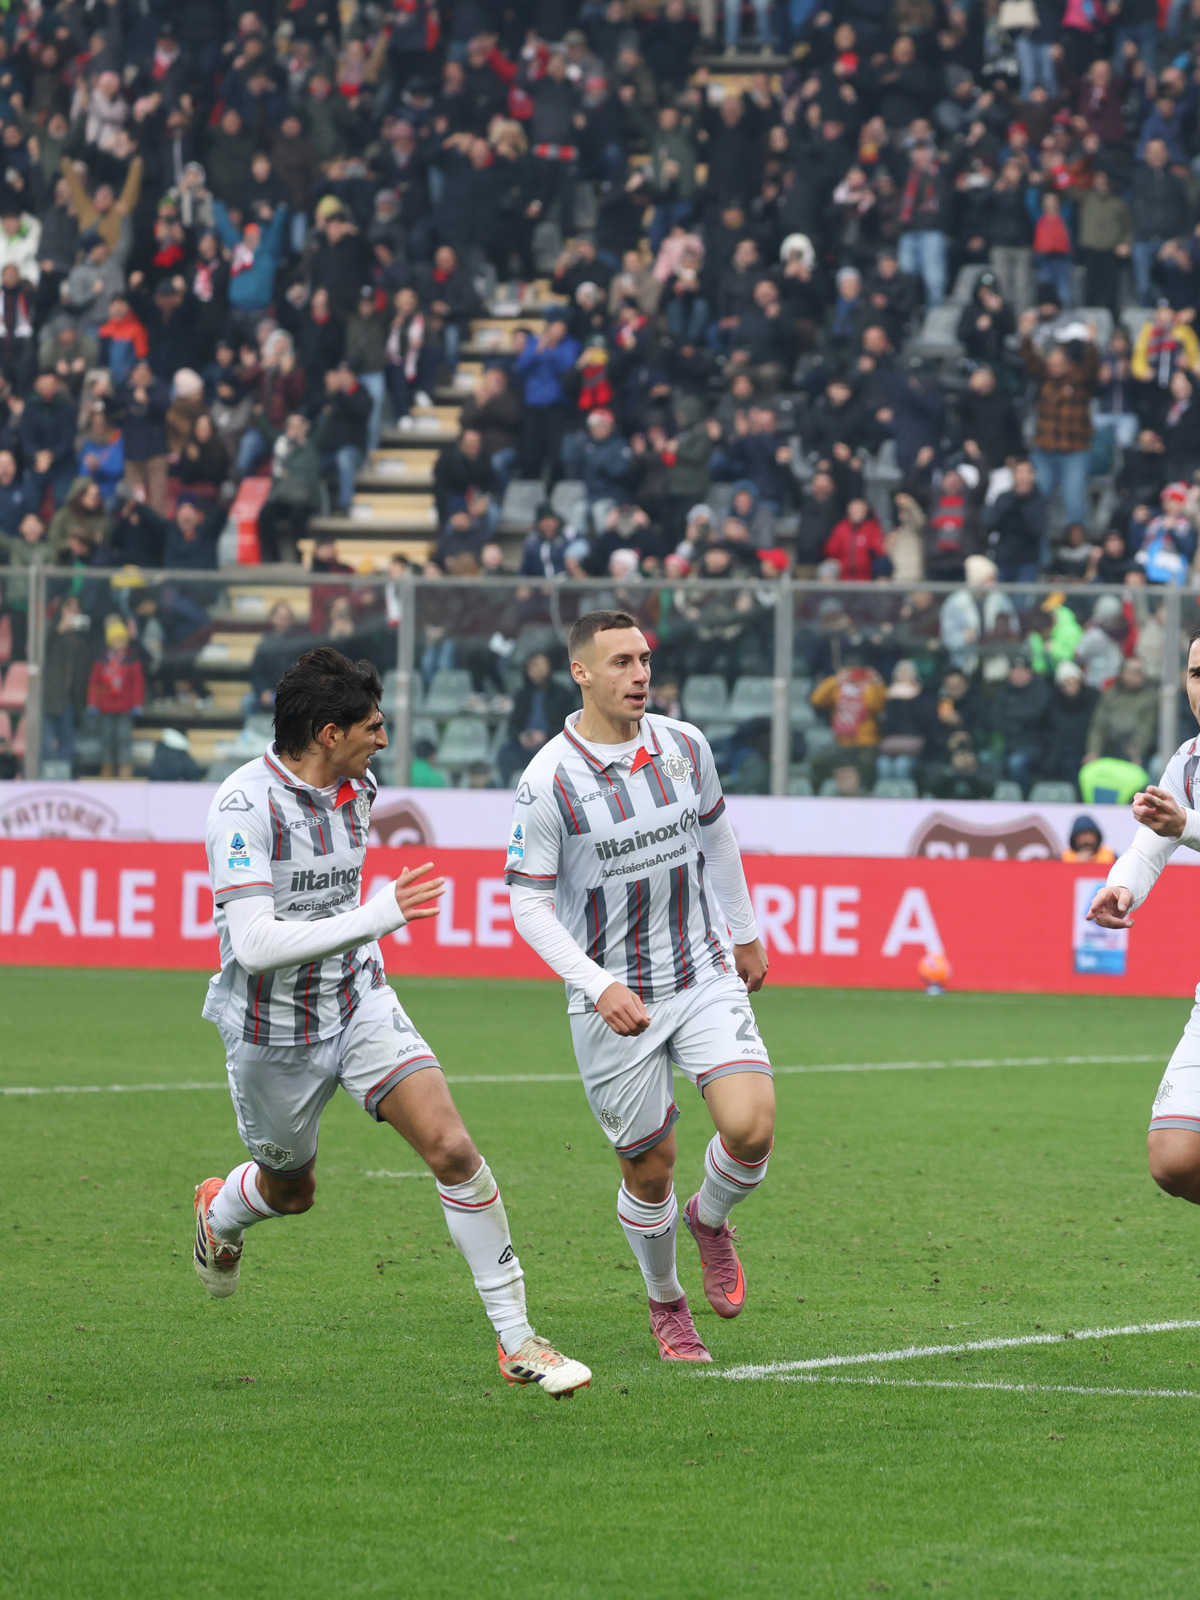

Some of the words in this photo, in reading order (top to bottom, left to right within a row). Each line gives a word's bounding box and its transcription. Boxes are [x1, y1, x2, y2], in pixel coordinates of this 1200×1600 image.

[571, 784, 621, 807] ACERBIS
[281, 815, 324, 832] ACERBIS
[602, 843, 687, 878] AcciaieriaArvedi
[752, 883, 860, 956] RIE
[881, 886, 946, 957] A
[391, 1006, 421, 1039] 4
